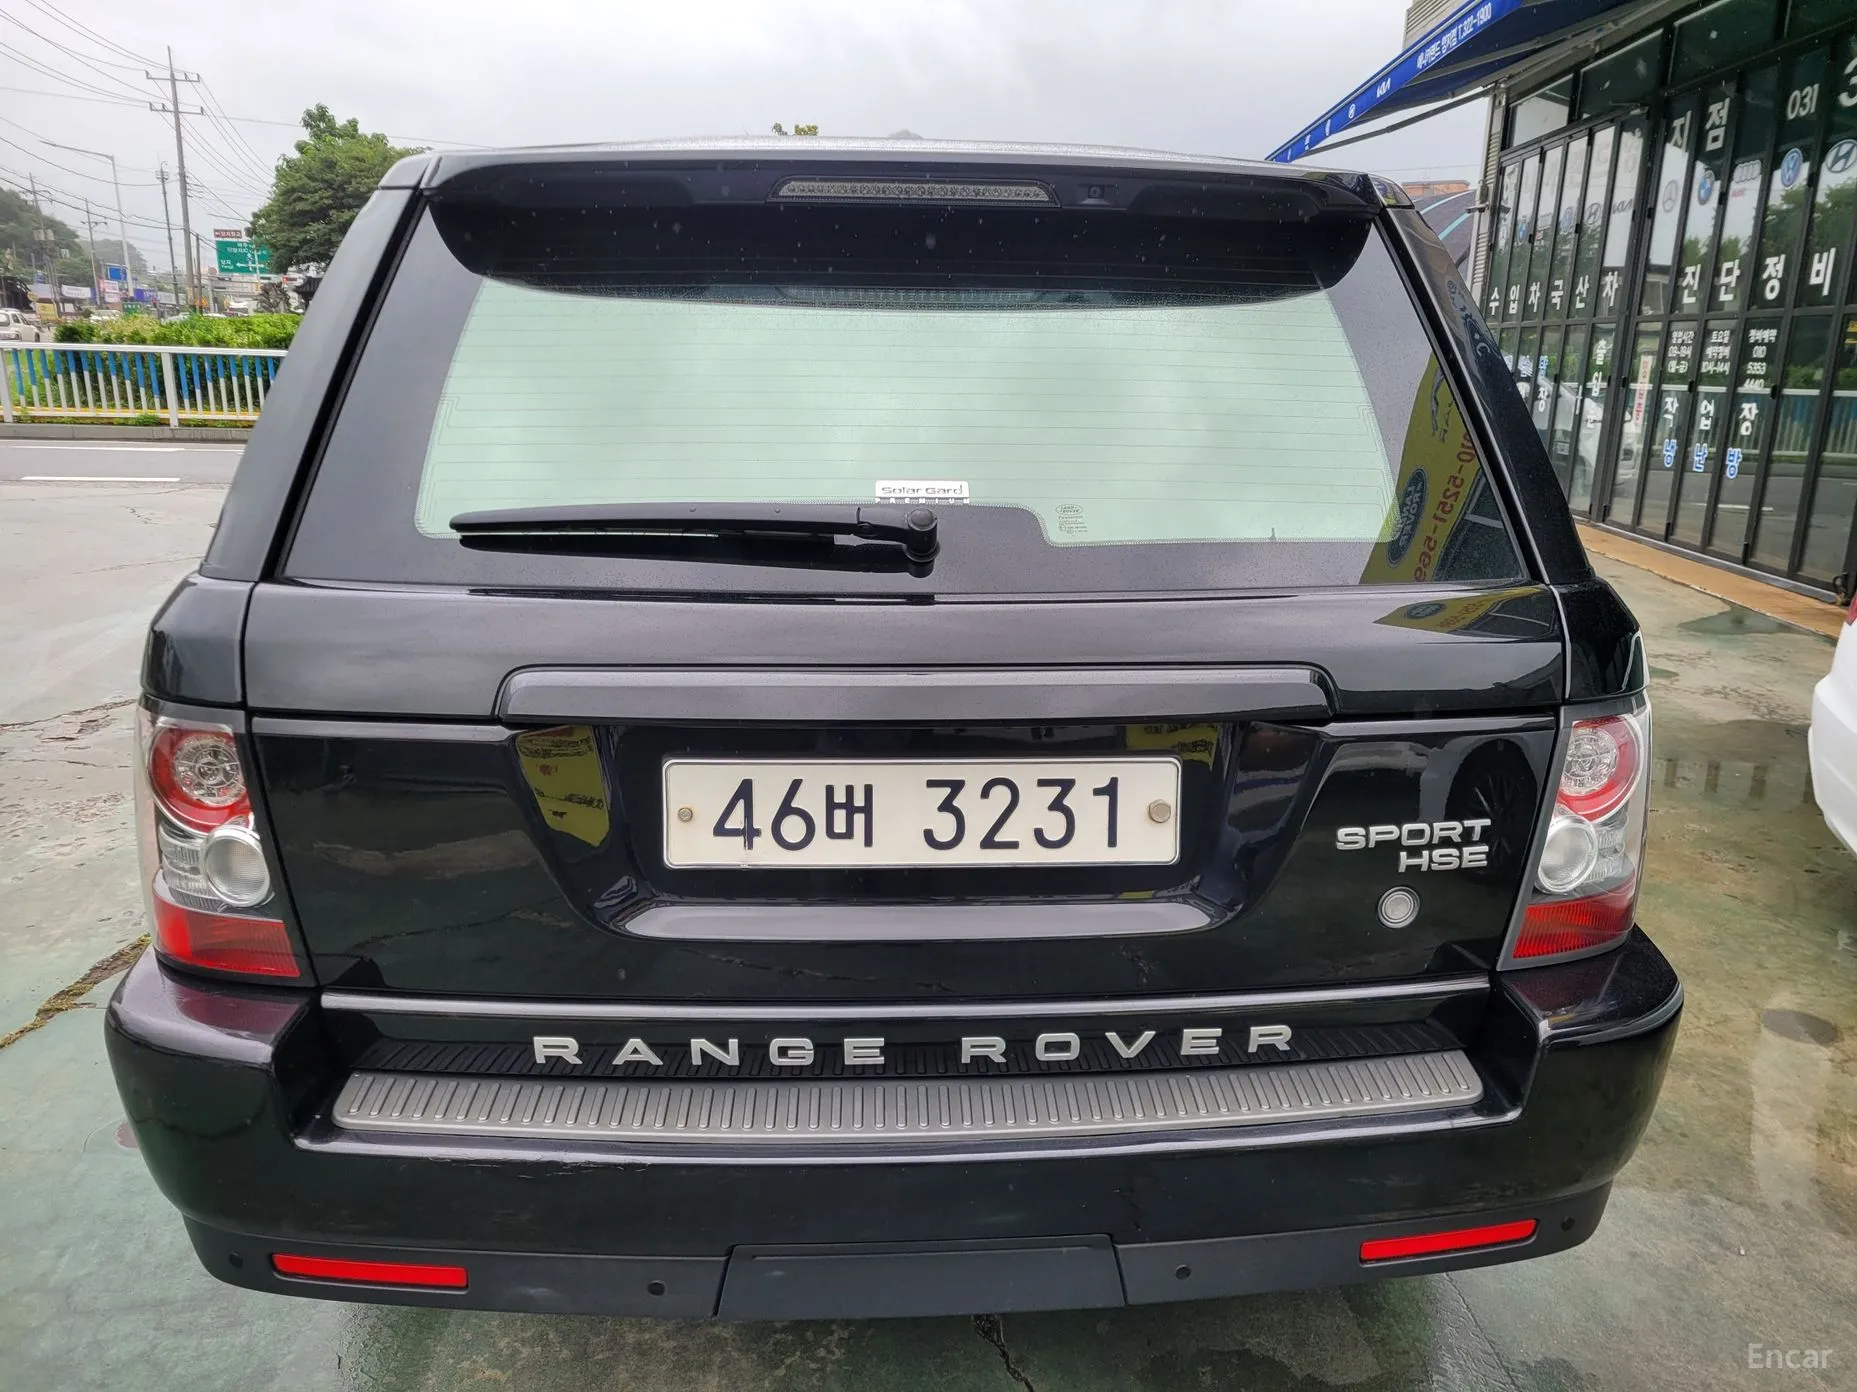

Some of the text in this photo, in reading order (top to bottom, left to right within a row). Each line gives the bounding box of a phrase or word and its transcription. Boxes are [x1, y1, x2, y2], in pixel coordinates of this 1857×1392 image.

[1787, 83, 1819, 120] 031
[881, 484, 963, 495] Solar Gard
[712, 777, 1119, 850] 46버 3231
[1336, 818, 1492, 850] SPORT
[1398, 845, 1489, 873] HSE
[532, 1024, 1293, 1067] RANGE ROVER
